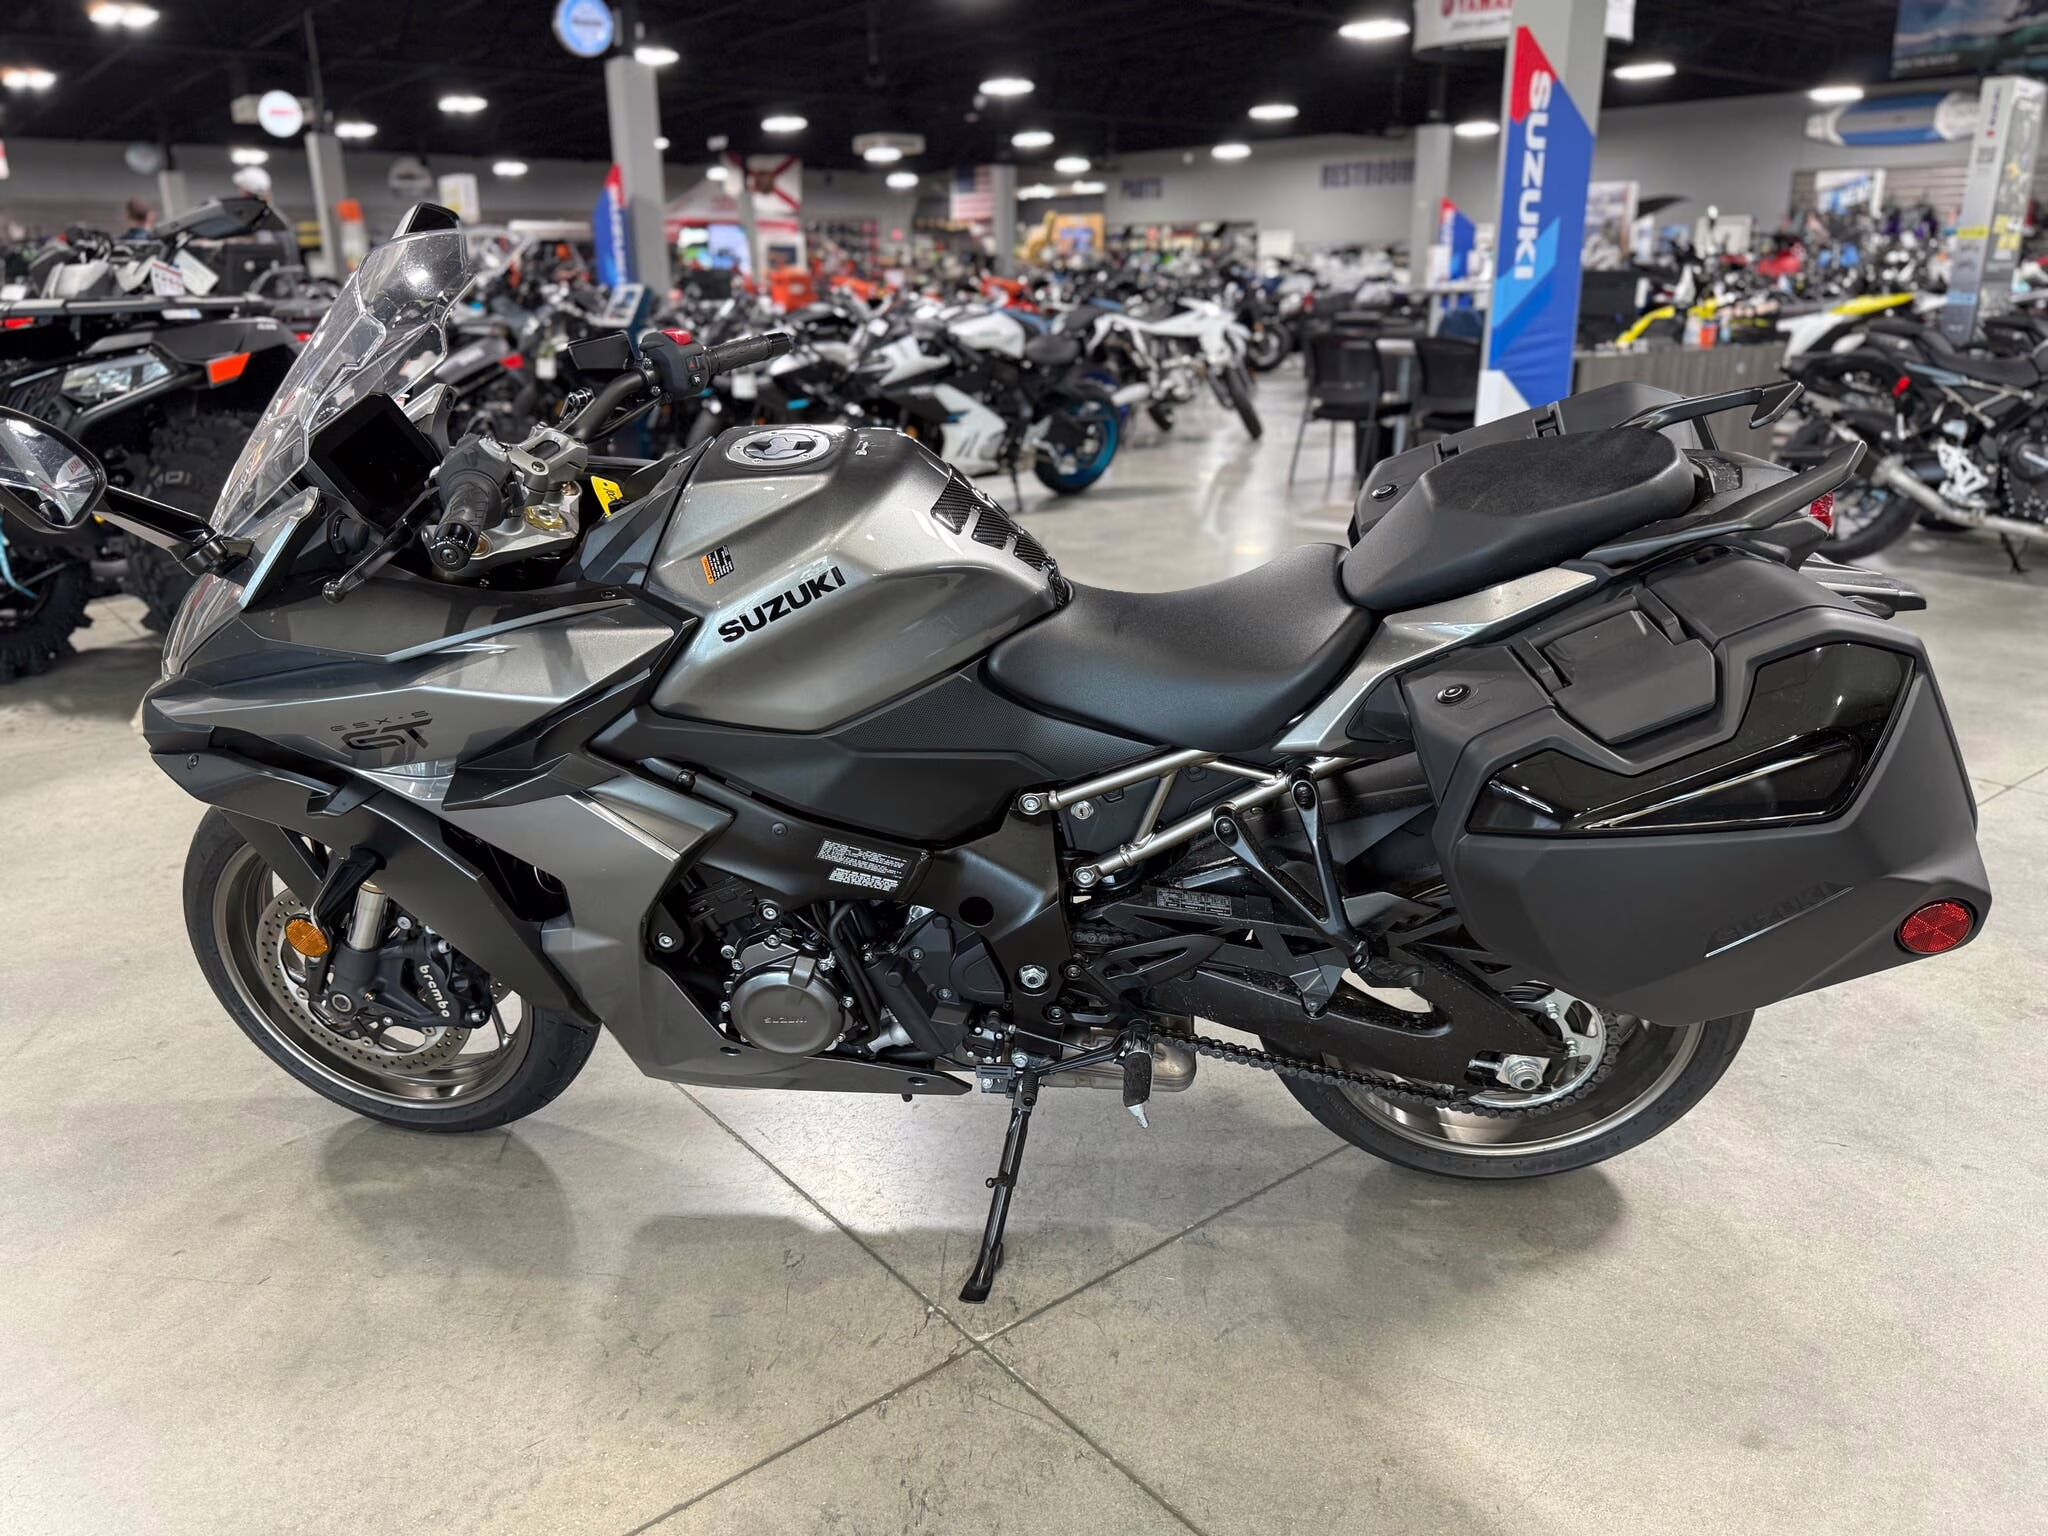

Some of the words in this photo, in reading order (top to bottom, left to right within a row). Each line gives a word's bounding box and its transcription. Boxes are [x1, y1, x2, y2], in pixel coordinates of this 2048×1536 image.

[1513, 69, 1552, 280] SUZUKI
[717, 566, 847, 643] SUZUKI
[330, 710, 429, 733] GSX-S
[341, 718, 433, 751] GT
[419, 964, 450, 1018] brembo
